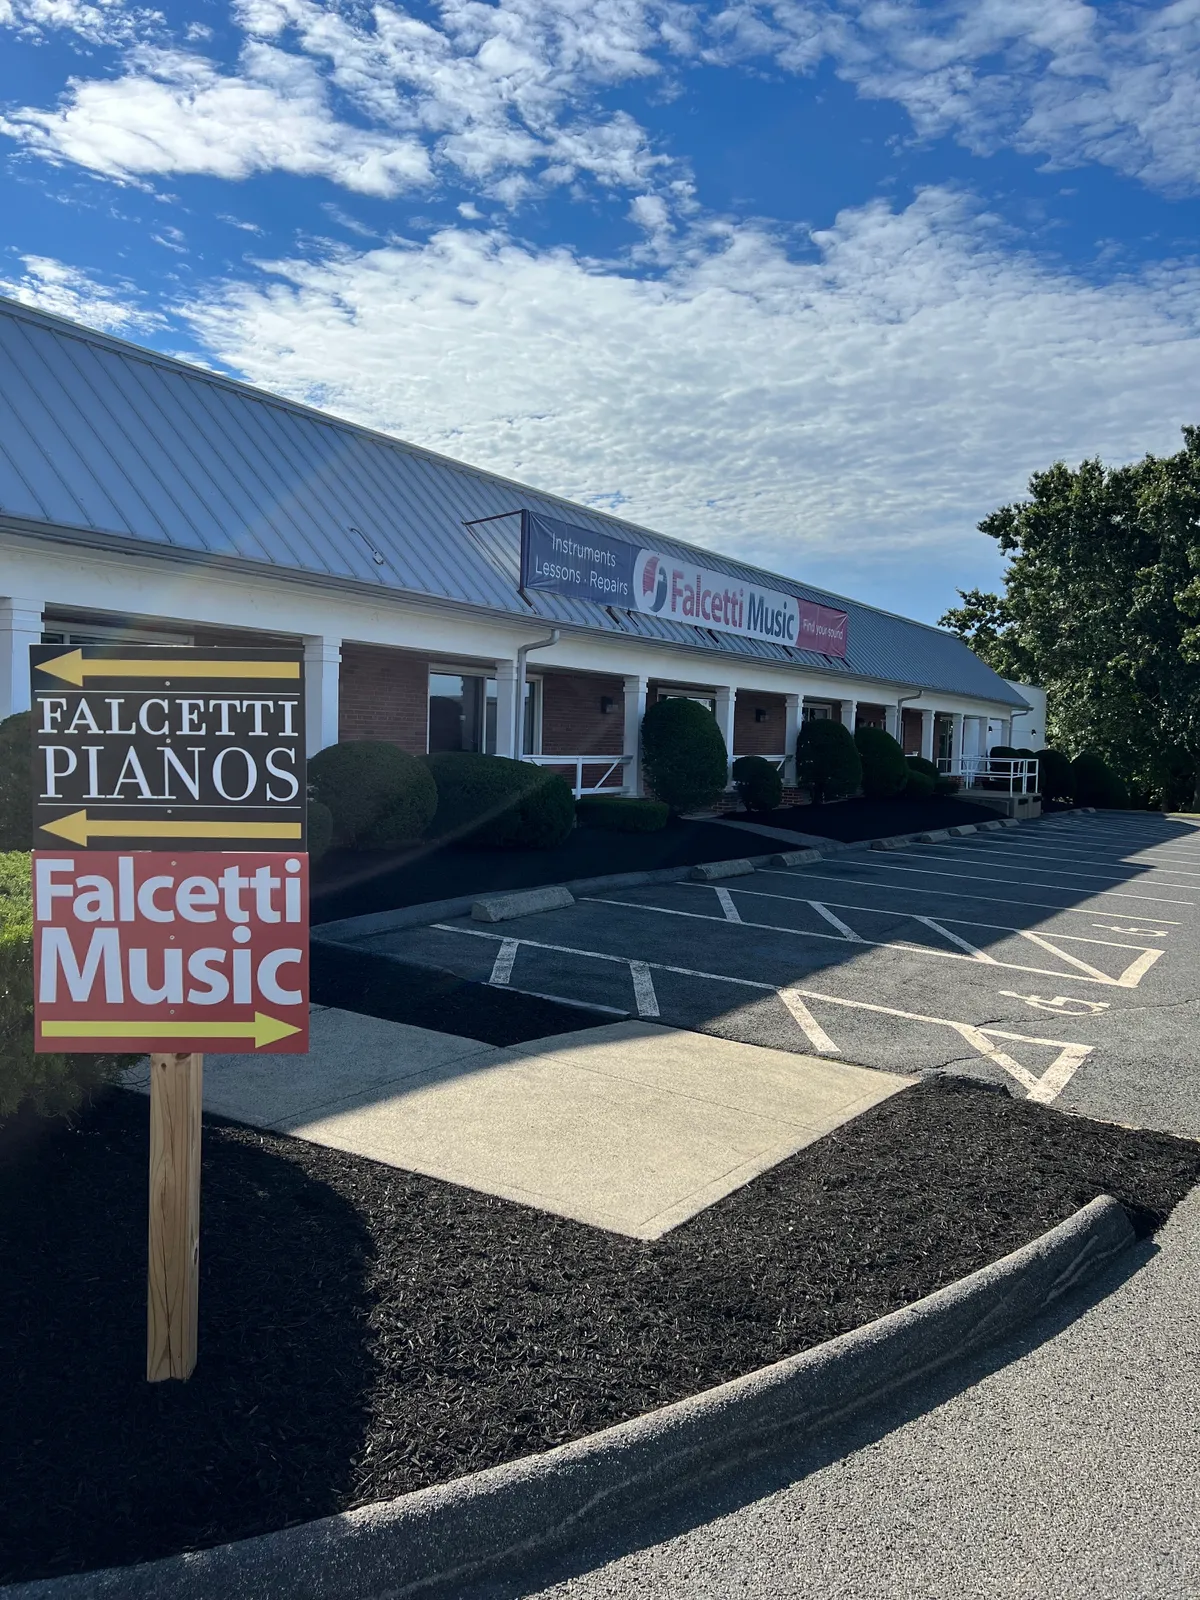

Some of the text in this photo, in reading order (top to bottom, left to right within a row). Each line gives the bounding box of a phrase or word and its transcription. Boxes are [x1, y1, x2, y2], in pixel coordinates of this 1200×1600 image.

[552, 532, 616, 567] Instruments
[535, 555, 628, 595] Lessons Repairs
[671, 569, 795, 640] Falcetti Music
[803, 619, 843, 640] Find your sound
[37, 698, 299, 736] FALCETTI
[38, 745, 299, 802] PIANOS
[35, 856, 301, 924] Falcetti
[38, 925, 303, 1006] Music
